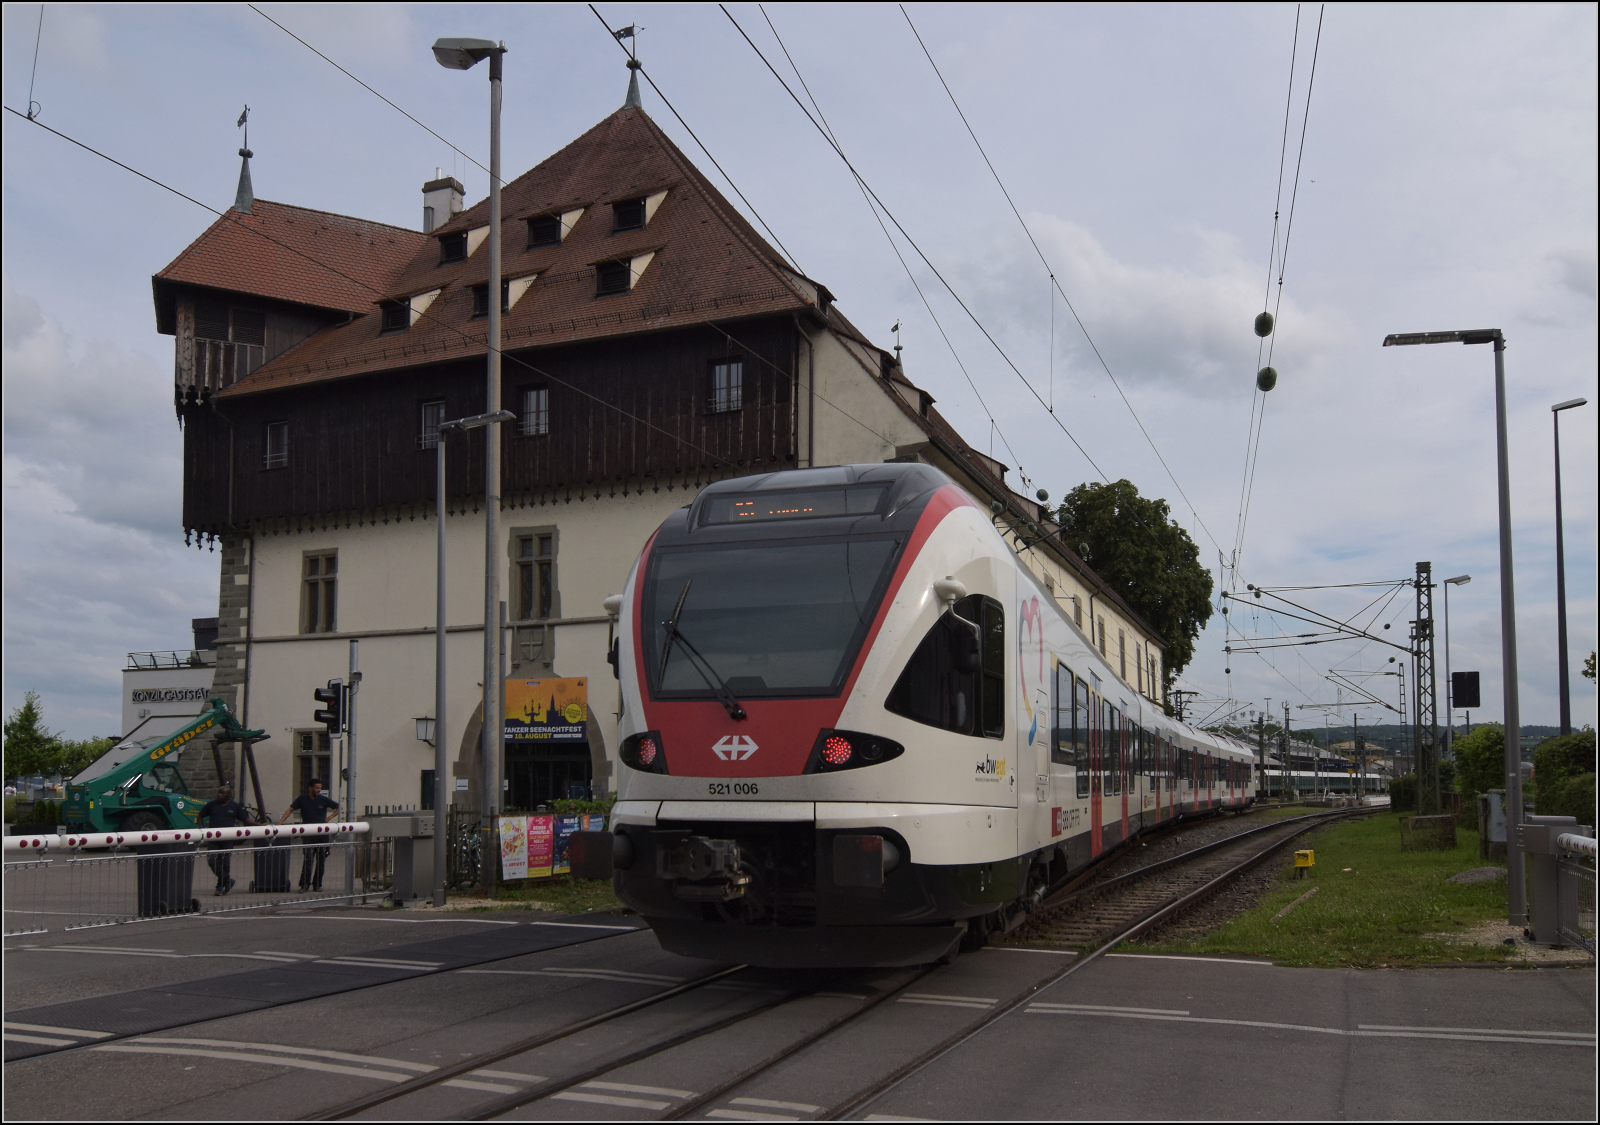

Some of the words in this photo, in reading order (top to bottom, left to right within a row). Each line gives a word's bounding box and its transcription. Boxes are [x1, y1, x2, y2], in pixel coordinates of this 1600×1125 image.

[133, 690, 164, 702] KONZIL
[149, 718, 215, 760] Gräber
[709, 783, 731, 795] 521
[734, 783, 758, 795] 006
